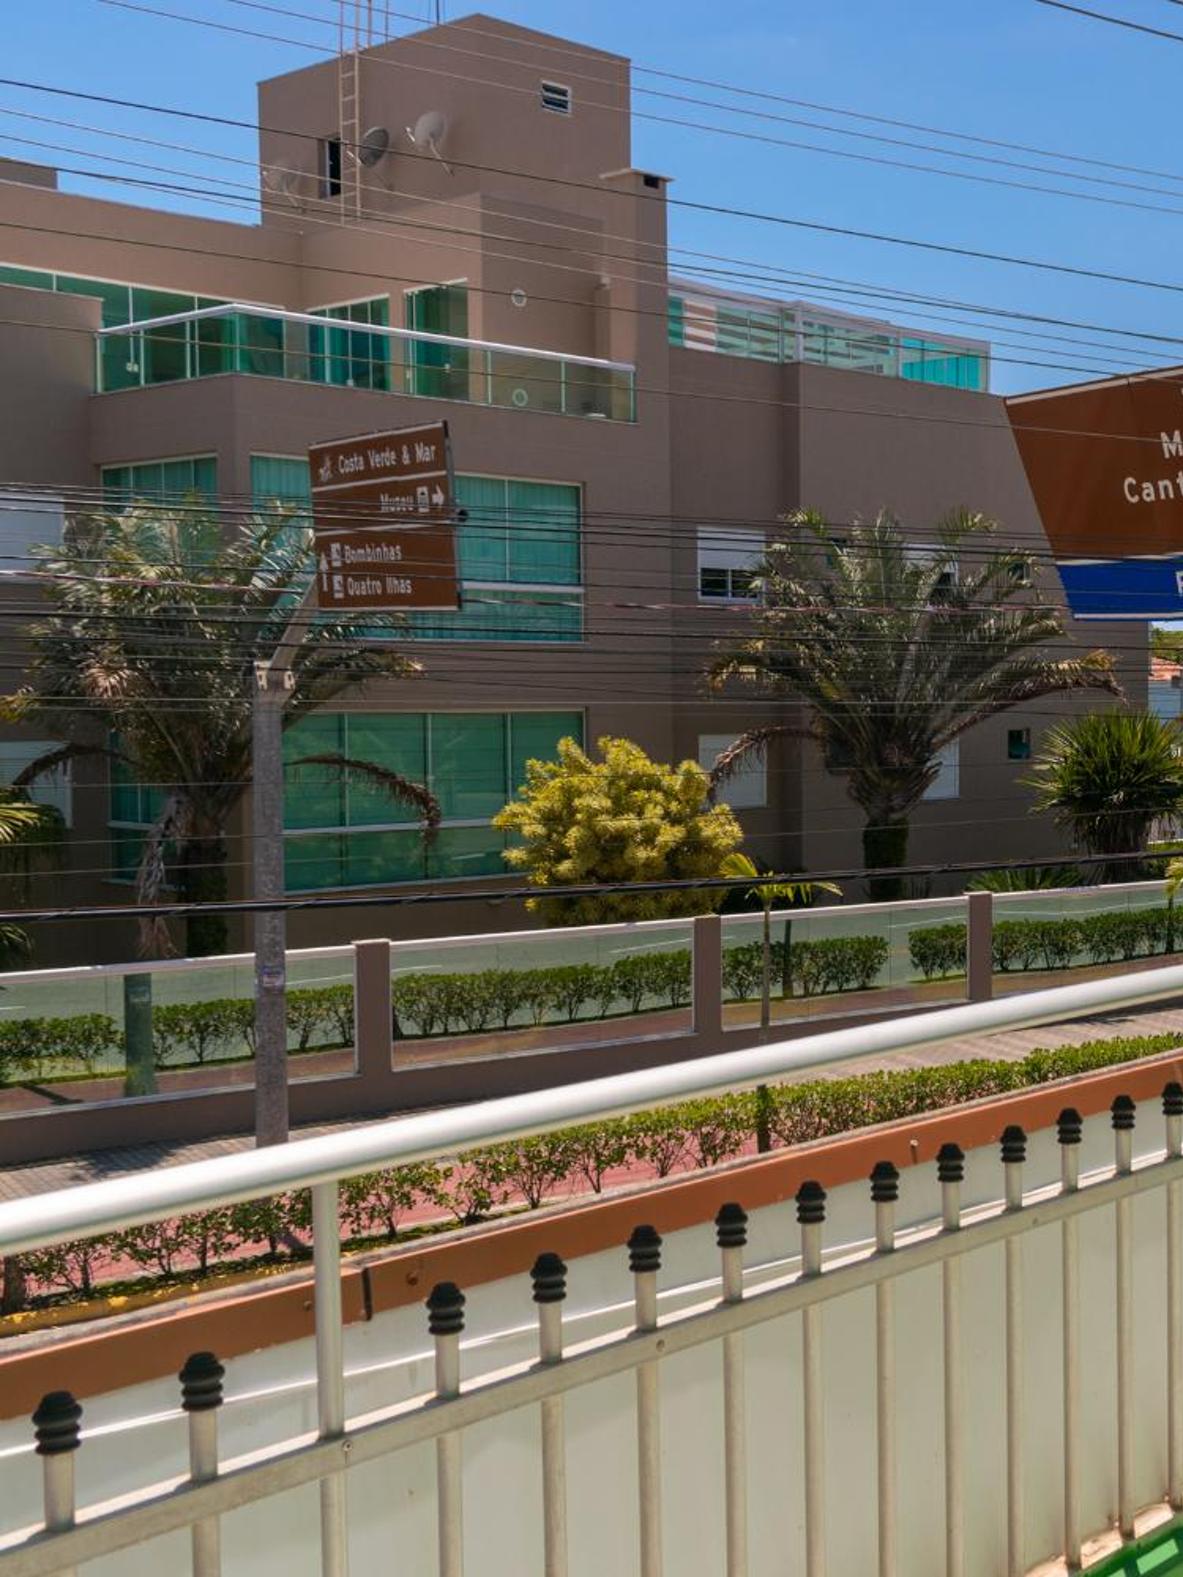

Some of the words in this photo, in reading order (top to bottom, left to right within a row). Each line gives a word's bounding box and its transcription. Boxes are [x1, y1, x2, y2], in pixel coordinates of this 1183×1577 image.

[338, 453, 364, 474] Costa
[367, 446, 397, 468] Verde
[402, 444, 411, 465] &
[414, 441, 436, 463] Mar
[347, 576, 383, 596] Quatro
